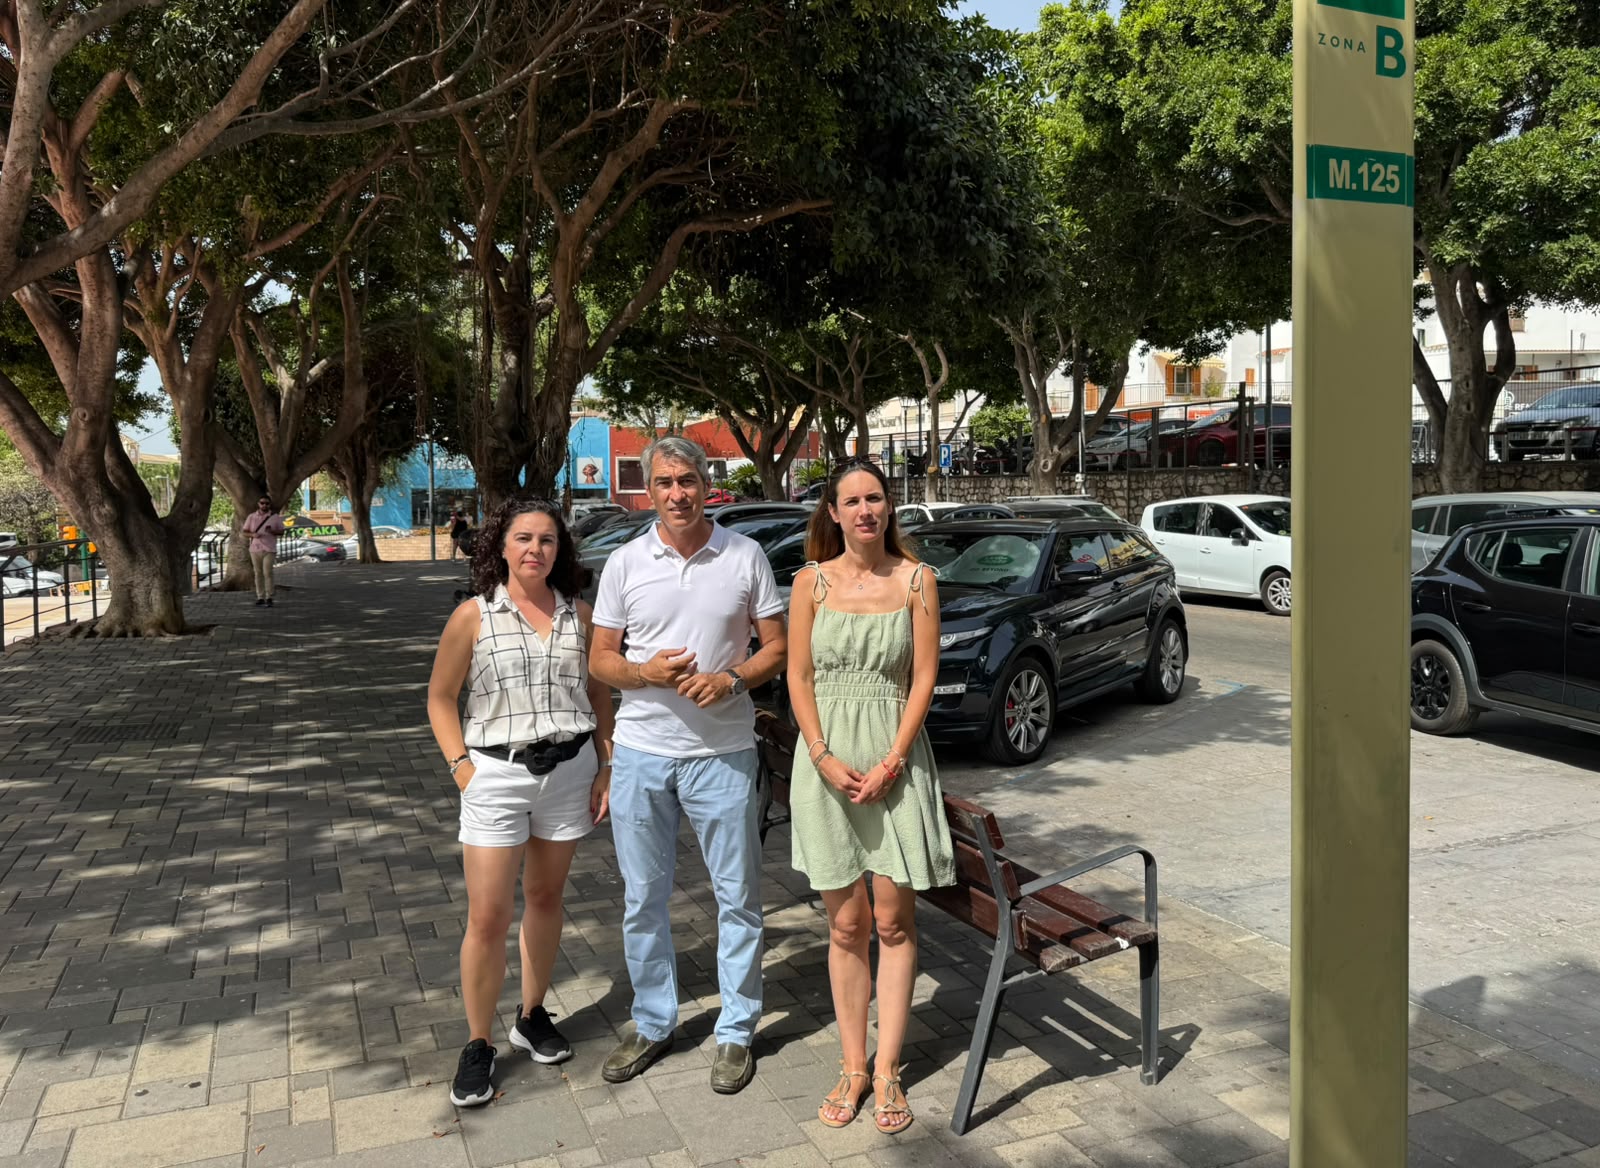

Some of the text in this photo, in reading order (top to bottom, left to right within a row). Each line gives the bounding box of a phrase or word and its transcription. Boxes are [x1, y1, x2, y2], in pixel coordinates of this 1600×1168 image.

[1318, 25, 1406, 78] ZONA B
[1328, 158, 1400, 194] M.125
[941, 446, 949, 465] P
